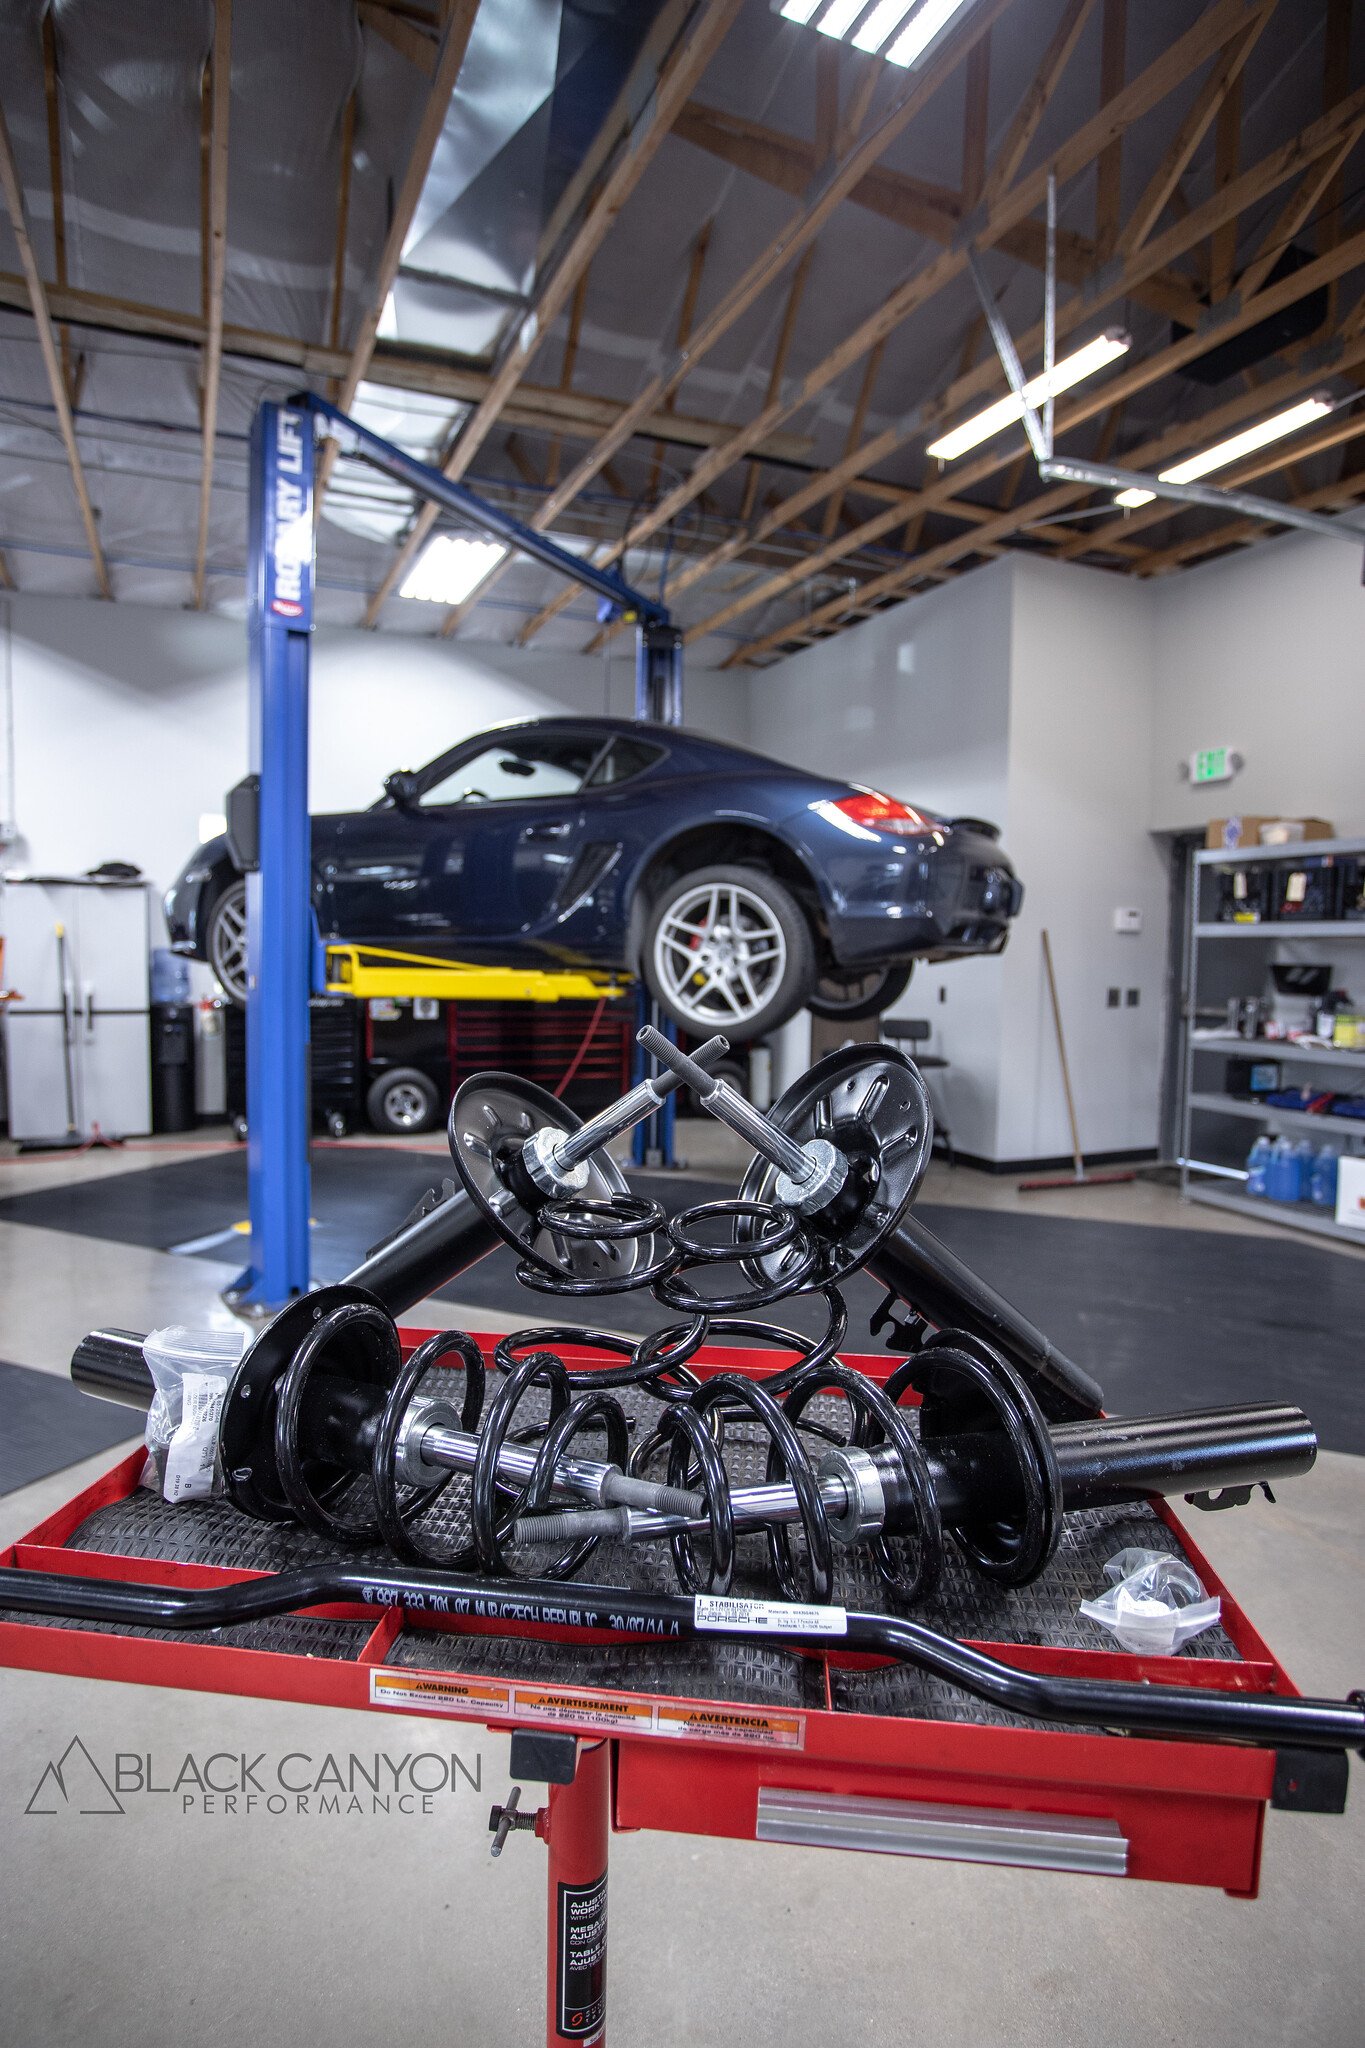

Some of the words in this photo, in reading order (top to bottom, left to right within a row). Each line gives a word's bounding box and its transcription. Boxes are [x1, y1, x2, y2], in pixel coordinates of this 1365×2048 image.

[276, 409, 303, 474] LIFT
[275, 476, 302, 601] ROARY
[697, 1615, 768, 1625] PORSCHE
[423, 1683, 469, 1695] WARNING
[547, 1697, 629, 1713] AVERTISSEMENT
[699, 1713, 769, 1728] AVERTENCIA
[570, 1920, 600, 1934] MESA
[570, 1942, 601, 1958] TABLE
